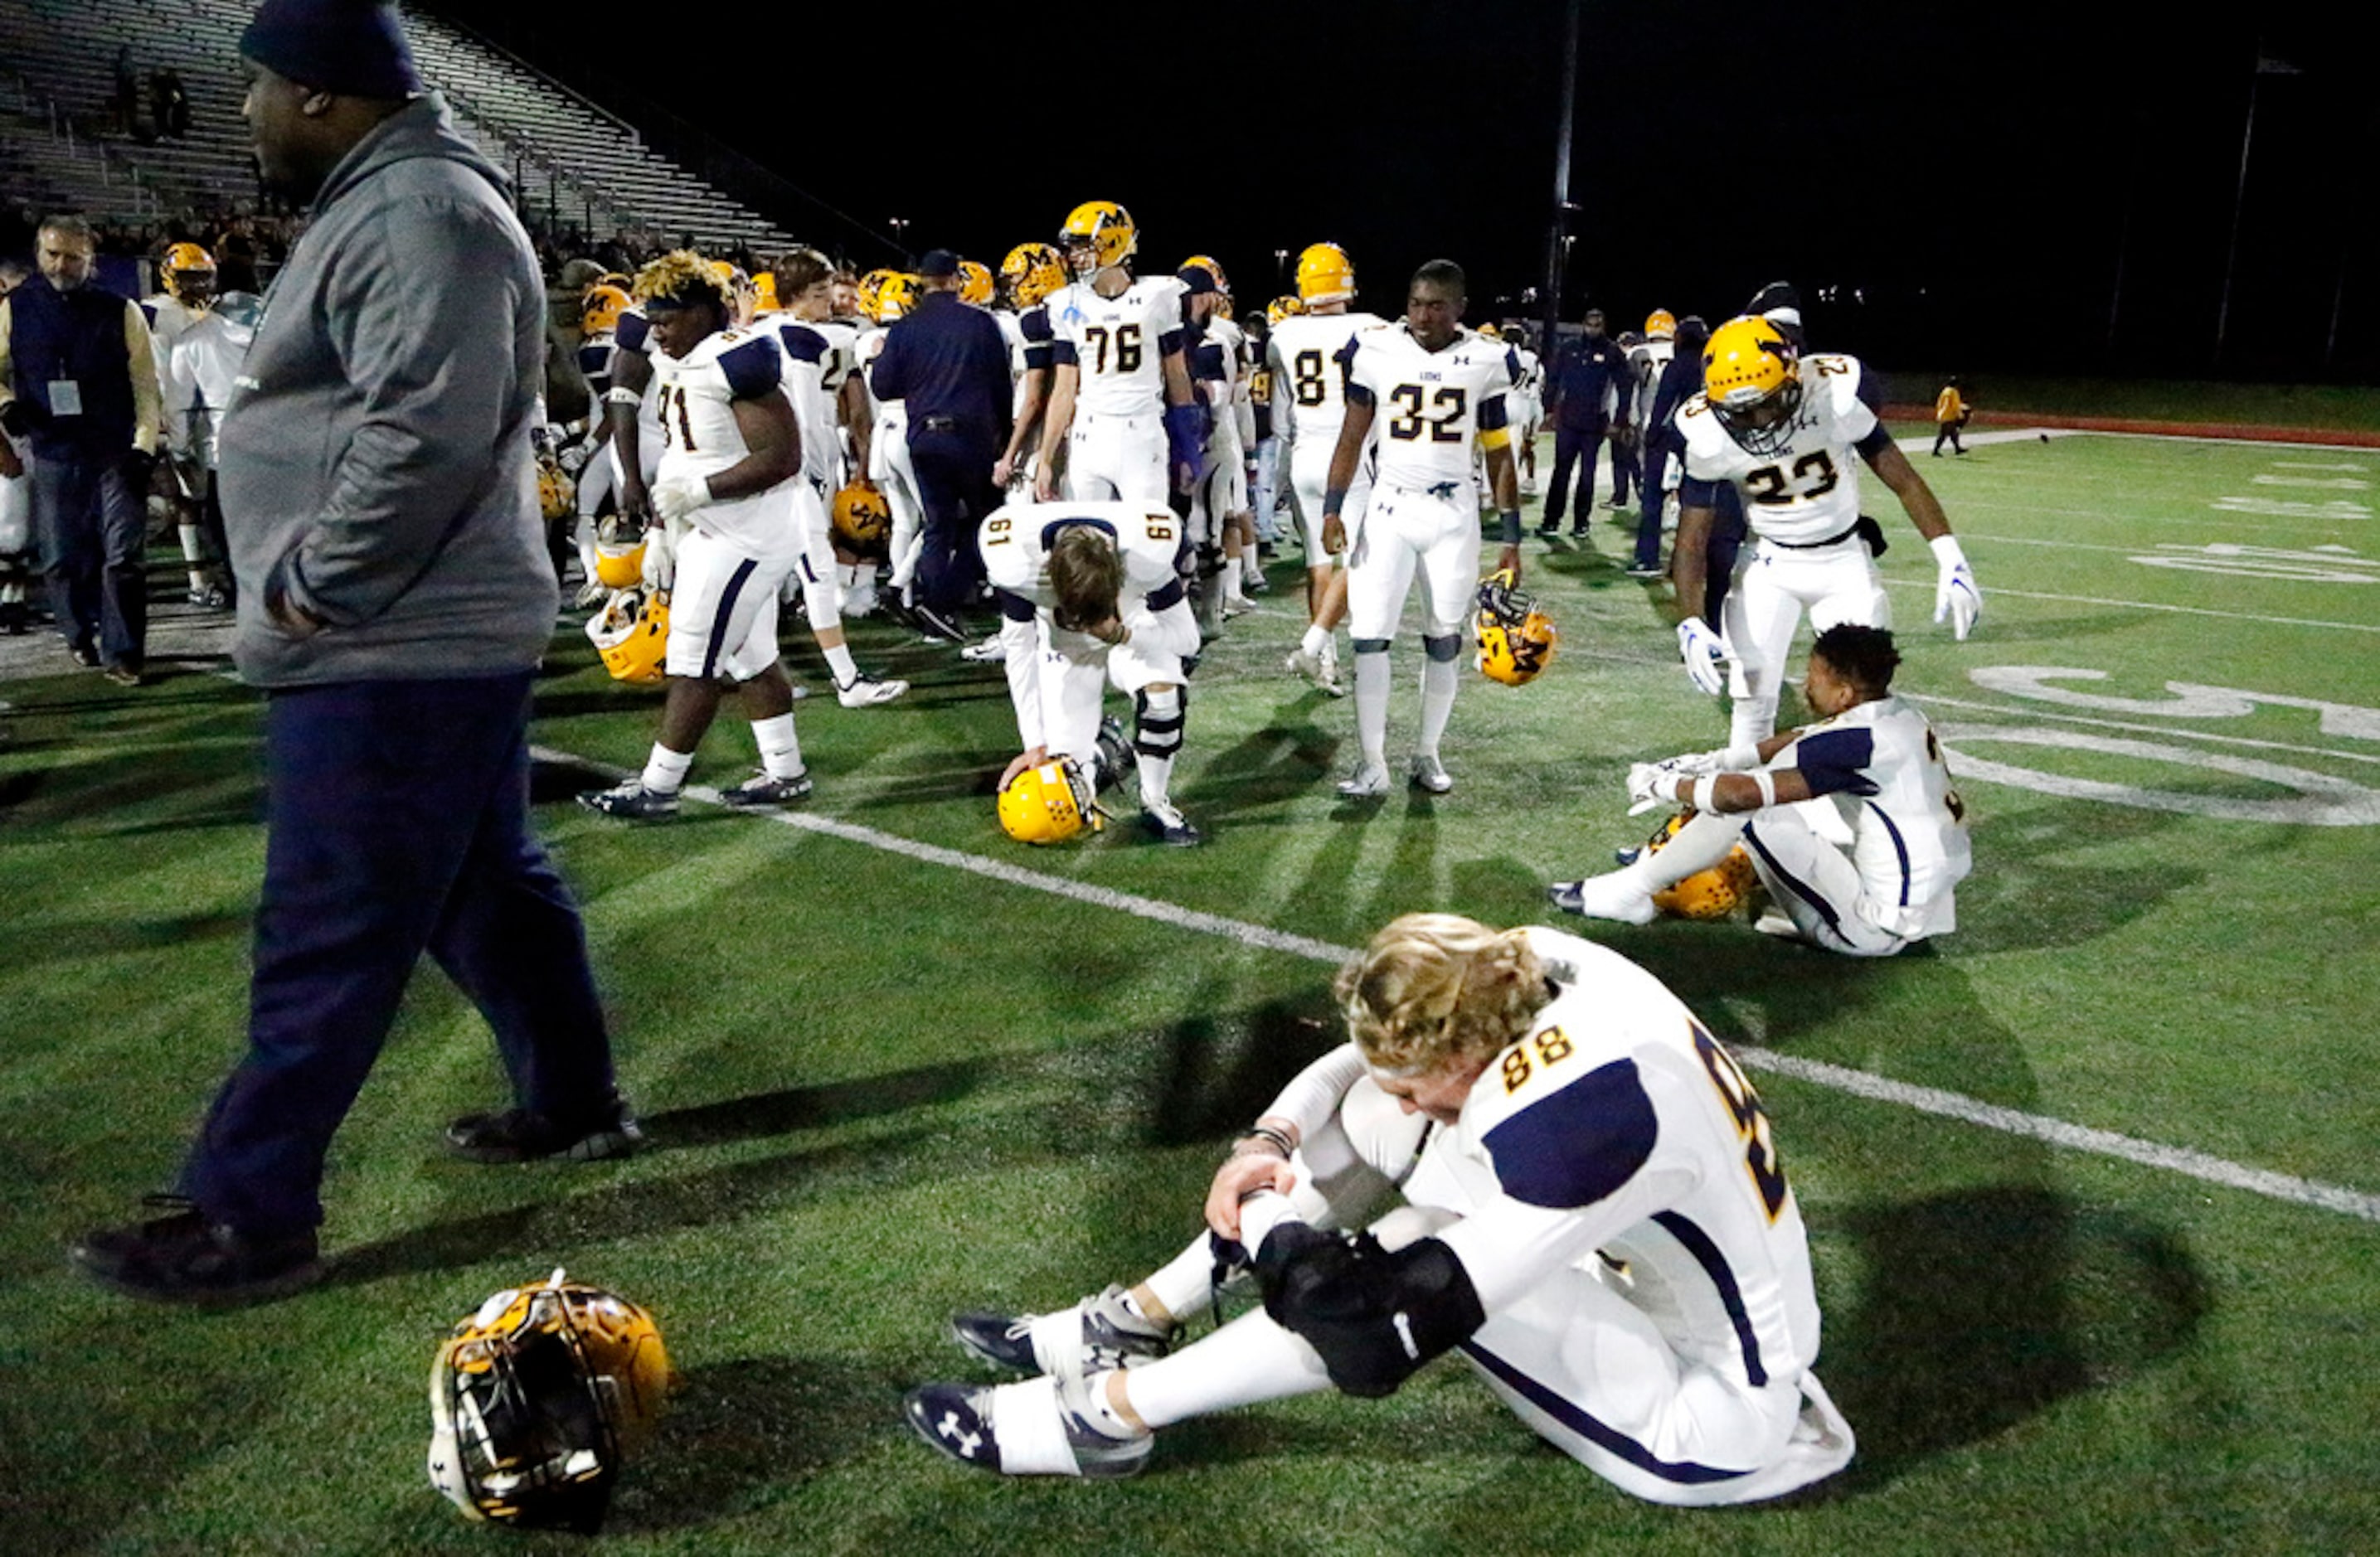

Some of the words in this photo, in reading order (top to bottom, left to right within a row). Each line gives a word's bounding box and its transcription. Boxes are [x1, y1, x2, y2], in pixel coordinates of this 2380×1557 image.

[1085, 323, 1142, 374] 76
[658, 382, 697, 452] 91
[1390, 383, 1467, 443] 32
[1745, 449, 1838, 504] 23
[987, 517, 1012, 547] 61
[1145, 512, 1173, 541] 61
[1500, 1024, 1571, 1096] 88
